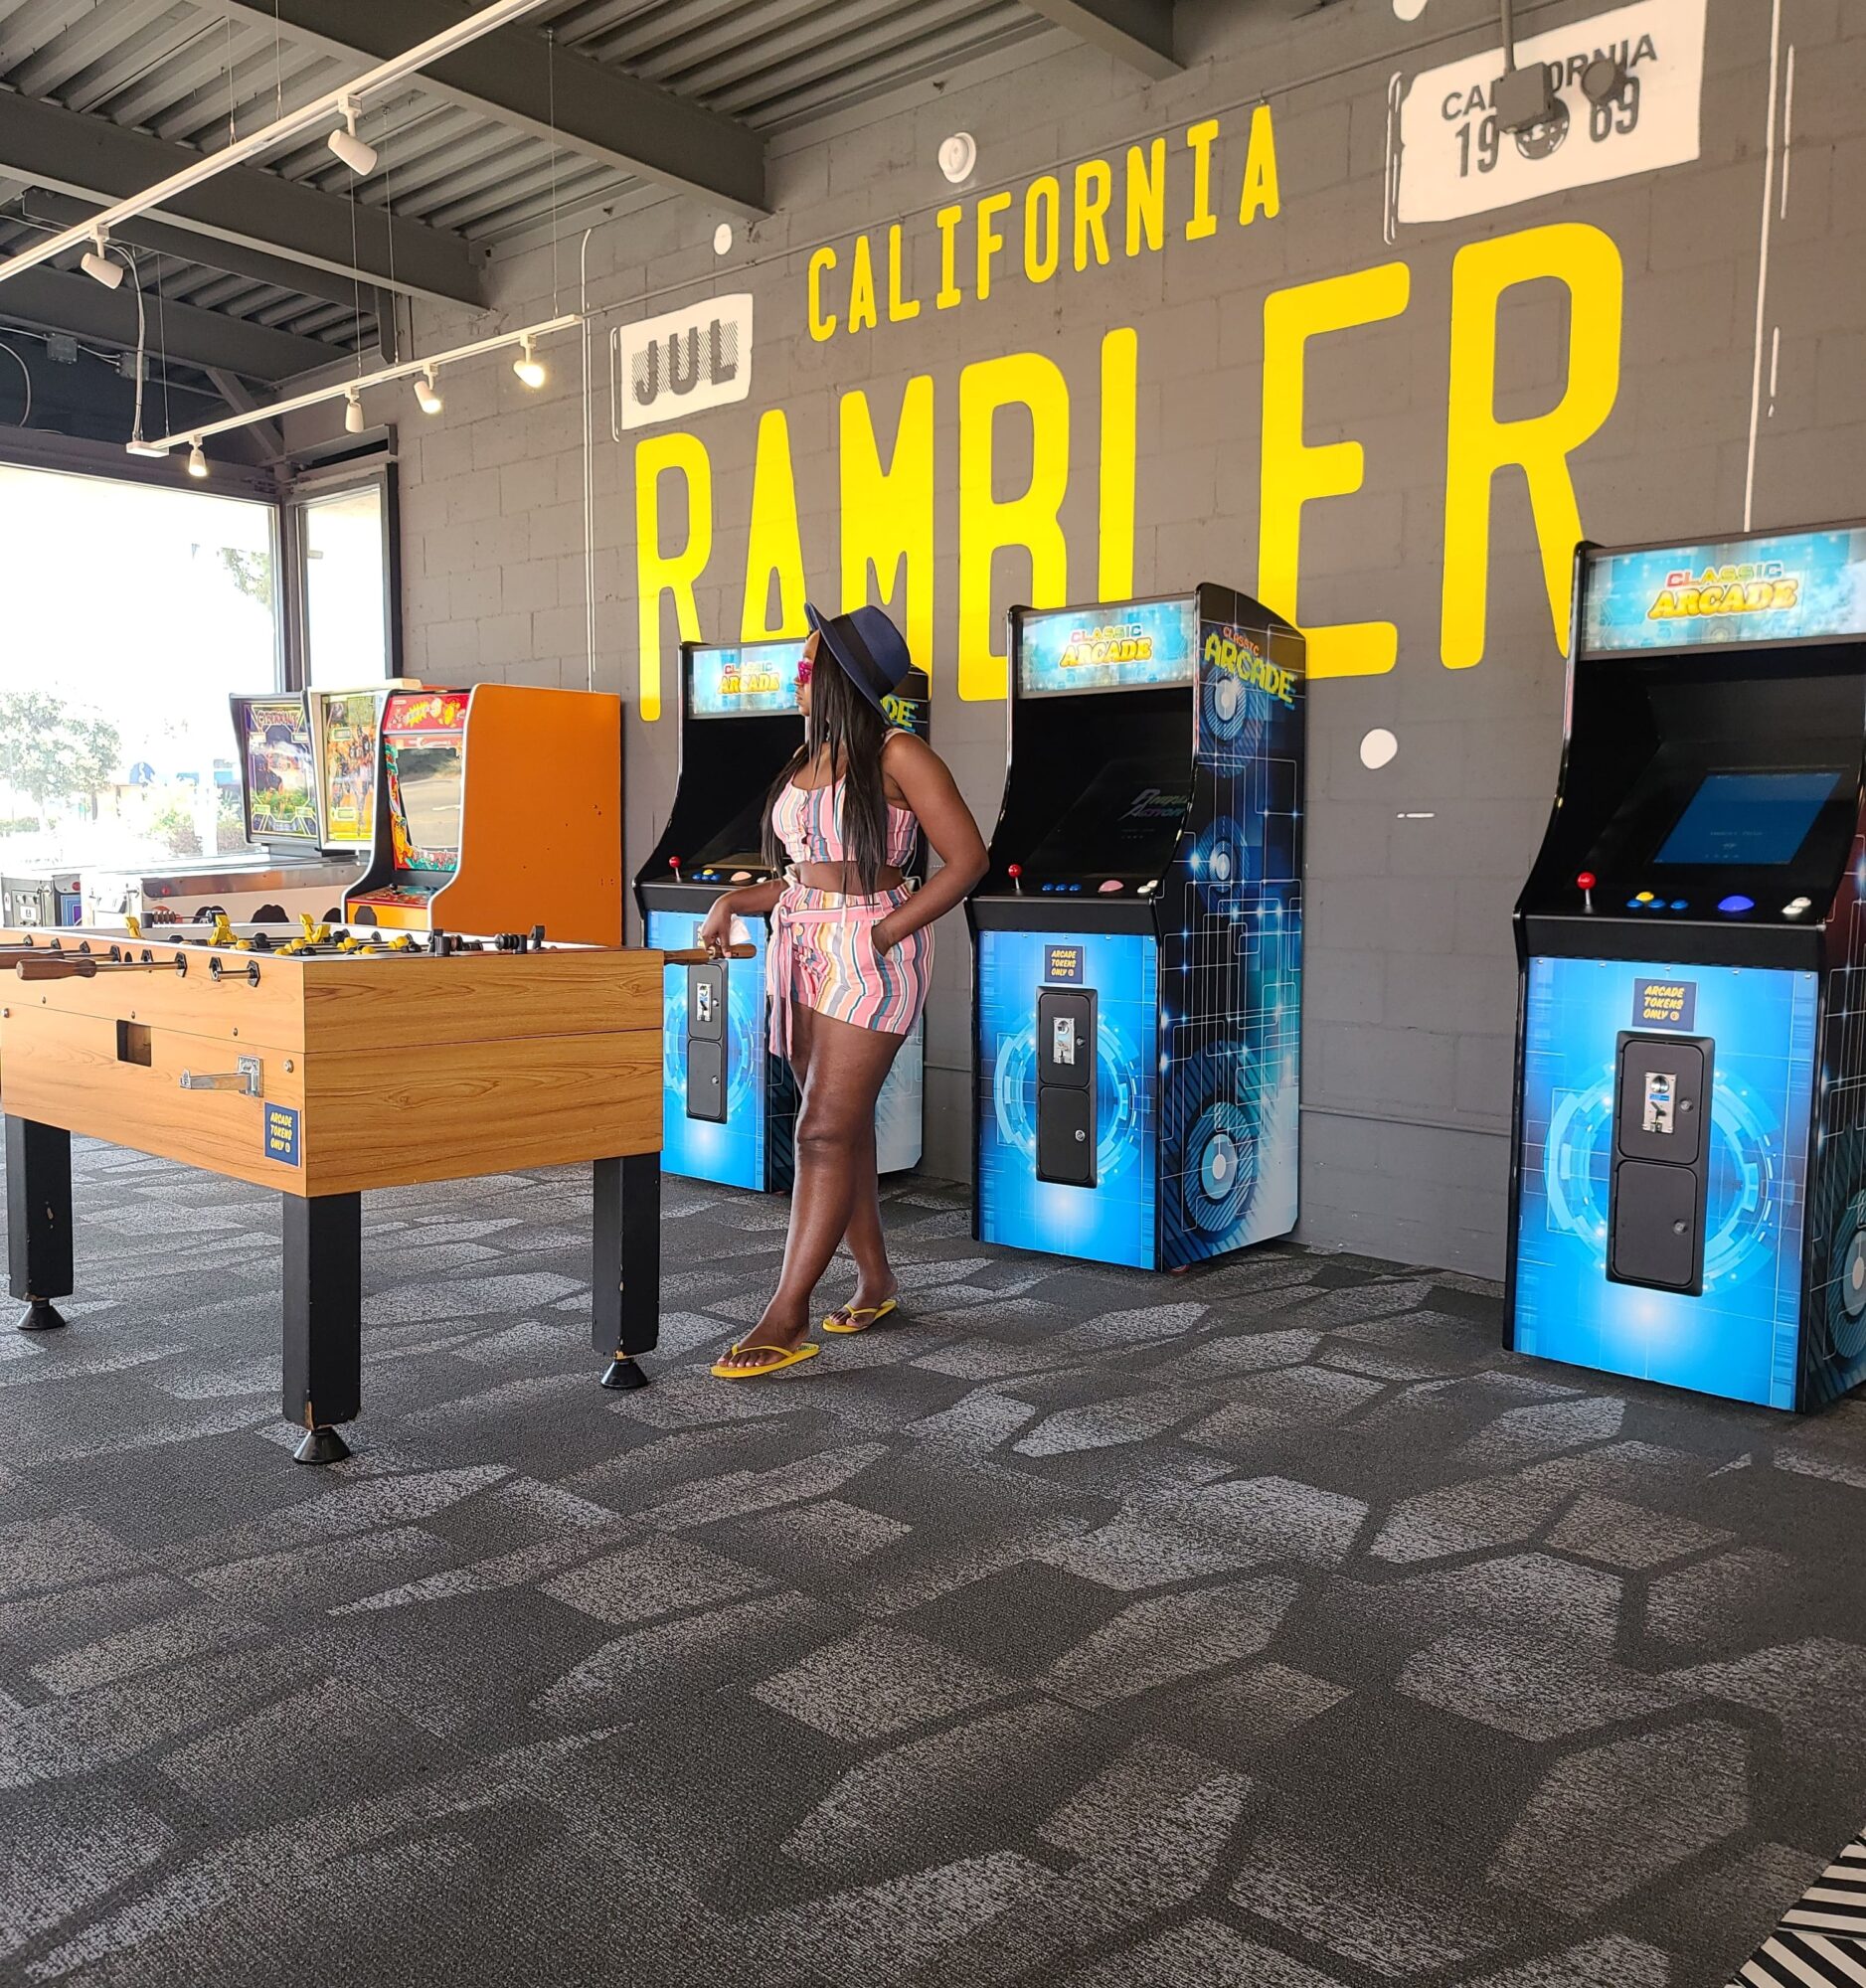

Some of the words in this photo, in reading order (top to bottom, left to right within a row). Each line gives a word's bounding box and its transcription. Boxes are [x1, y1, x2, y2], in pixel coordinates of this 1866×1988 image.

[807, 105, 1279, 341] CALIFORNIA
[634, 318, 738, 407] JUL
[1666, 563, 1782, 587] CLASSIC
[1647, 580, 1799, 620] ARCADE
[1071, 624, 1142, 643] CLASSIC
[1223, 626, 1260, 657] CLASSIC
[1060, 636, 1153, 668] ARCADE
[1204, 632, 1294, 704] ARCADE
[718, 673, 780, 694] ARCADE
[1051, 959, 1077, 968] TOKENS
[1051, 967, 1067, 976] ONLY
[1644, 985, 1685, 998] ARCADE
[1644, 996, 1684, 1009] TOKENS
[1643, 1008, 1669, 1020] ONLY
[270, 1111, 293, 1127] ARCADE
[270, 1124, 293, 1140] TOKENS
[270, 1137, 284, 1150] ONLY
